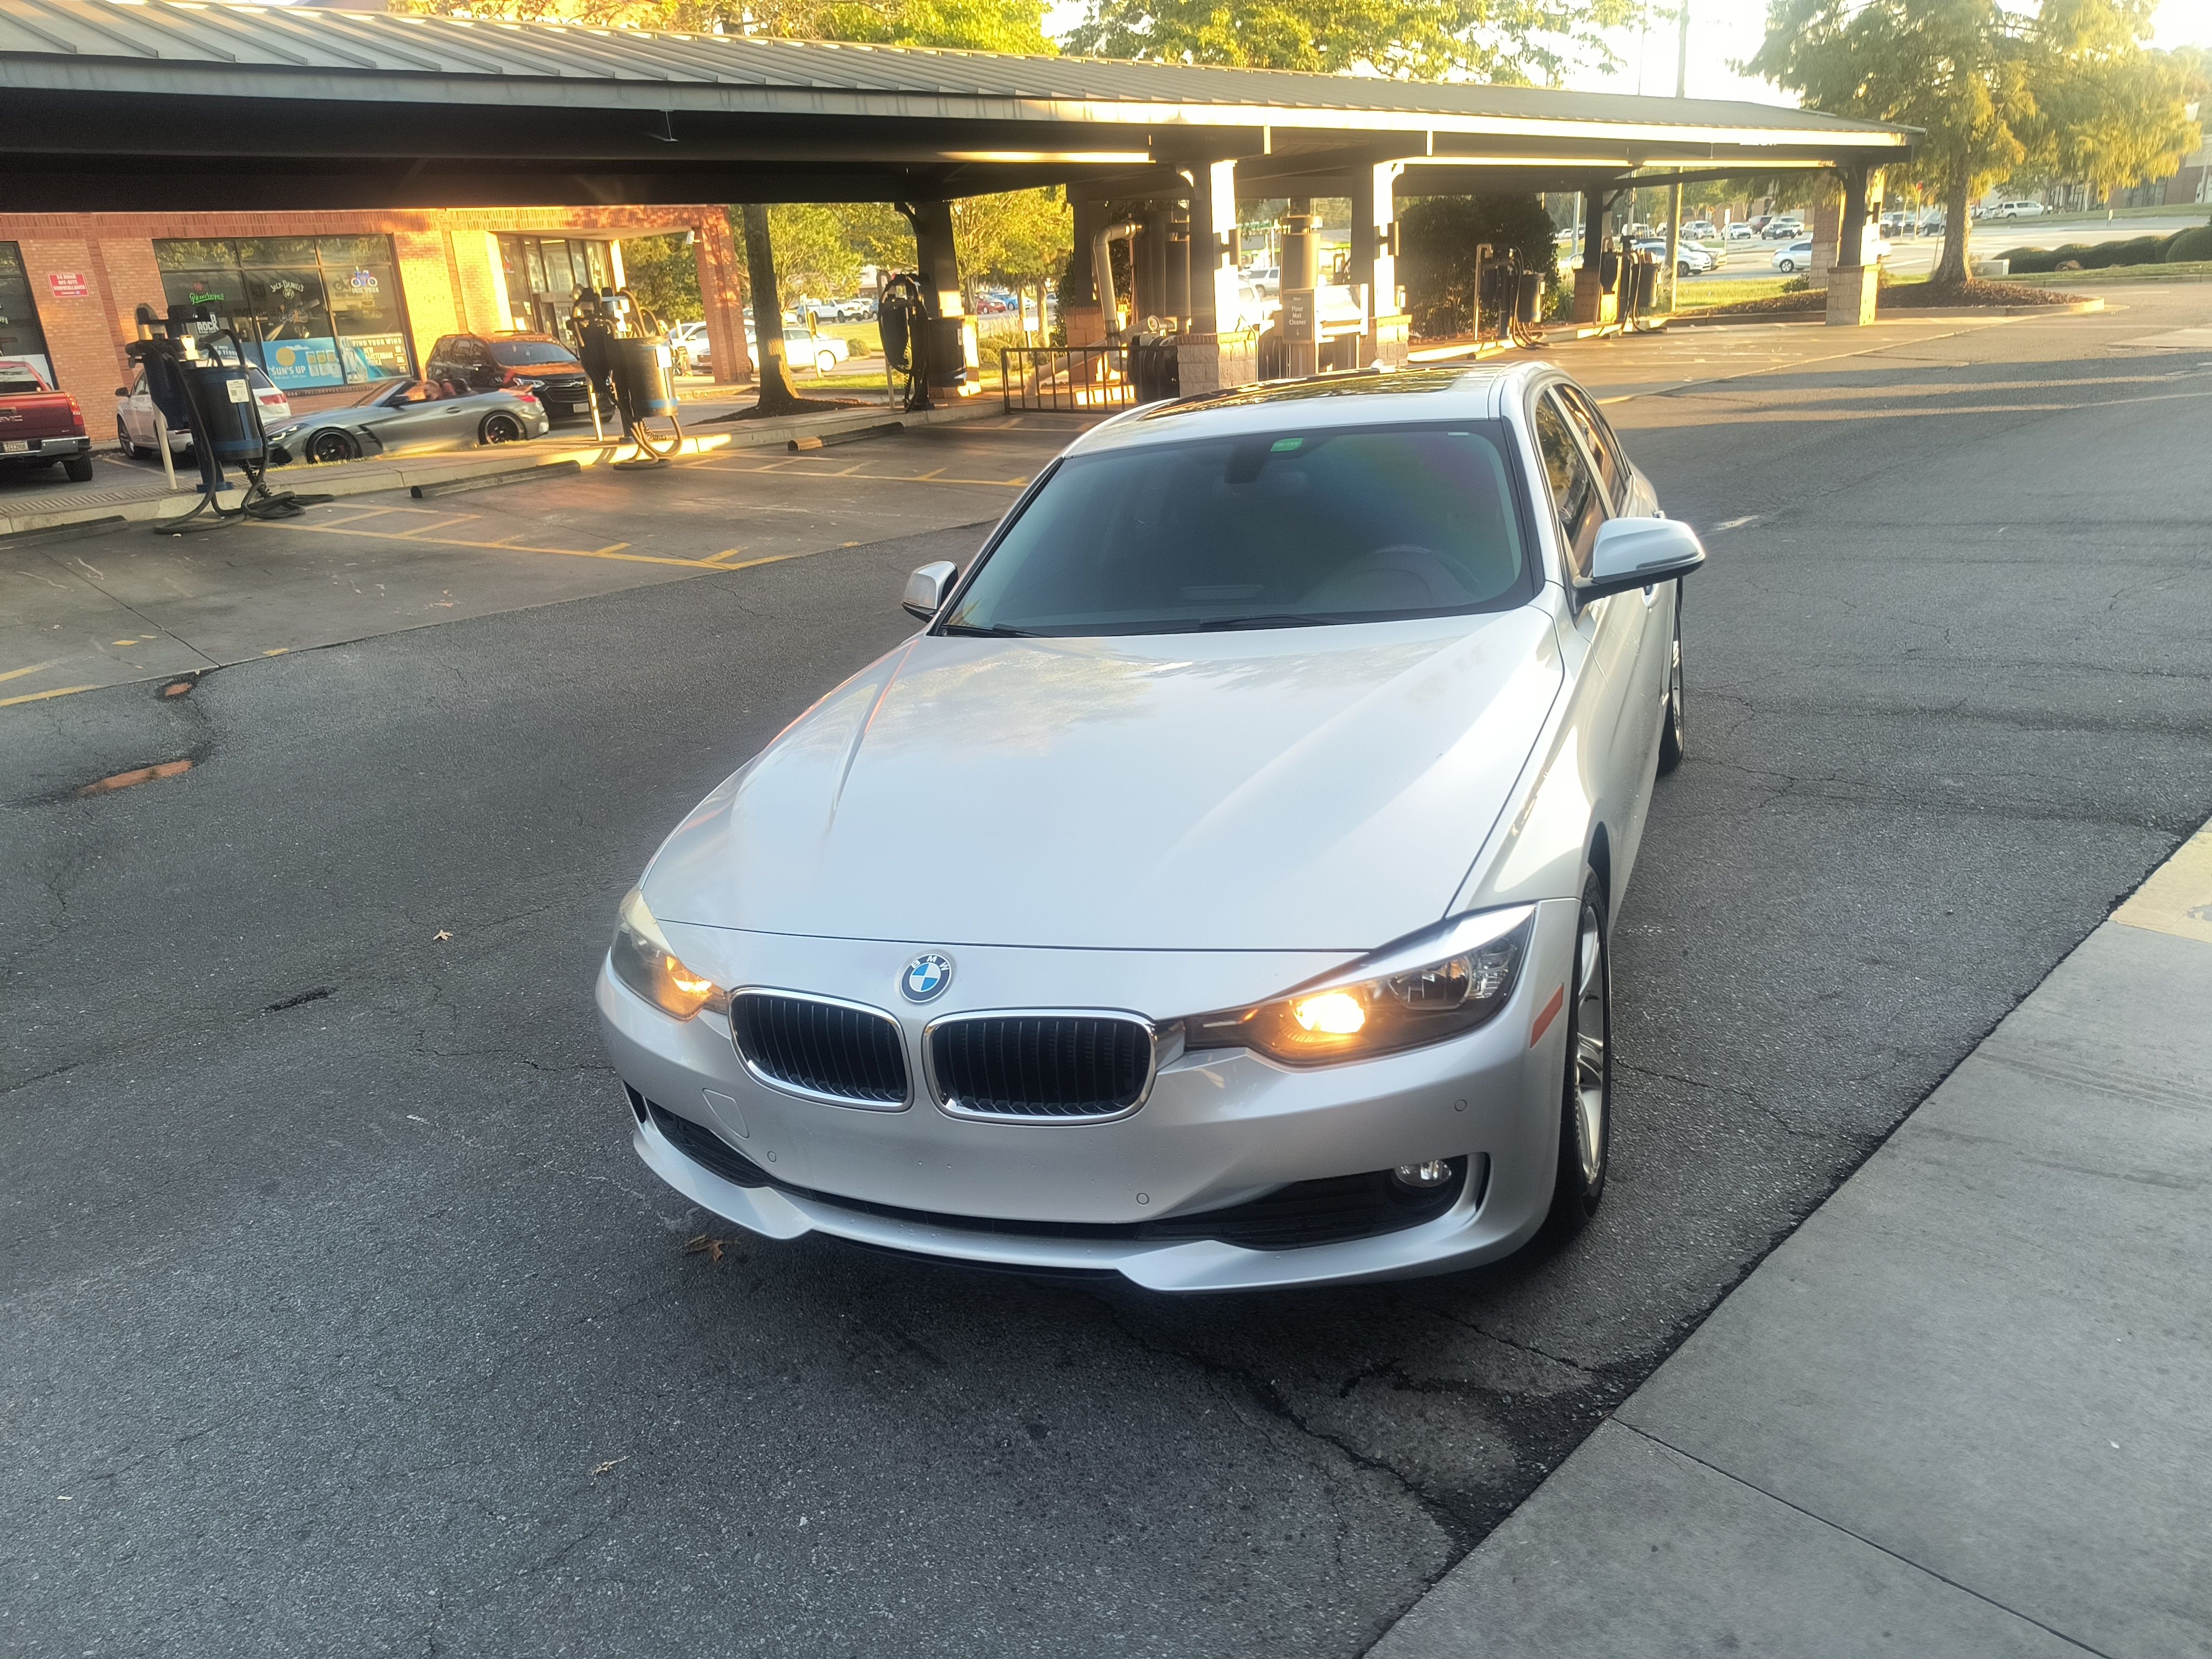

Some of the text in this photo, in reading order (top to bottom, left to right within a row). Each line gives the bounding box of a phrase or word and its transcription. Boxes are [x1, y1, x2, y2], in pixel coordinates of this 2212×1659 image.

[271, 365, 306, 376] SUN'S UP
[911, 955, 949, 971] BMW
